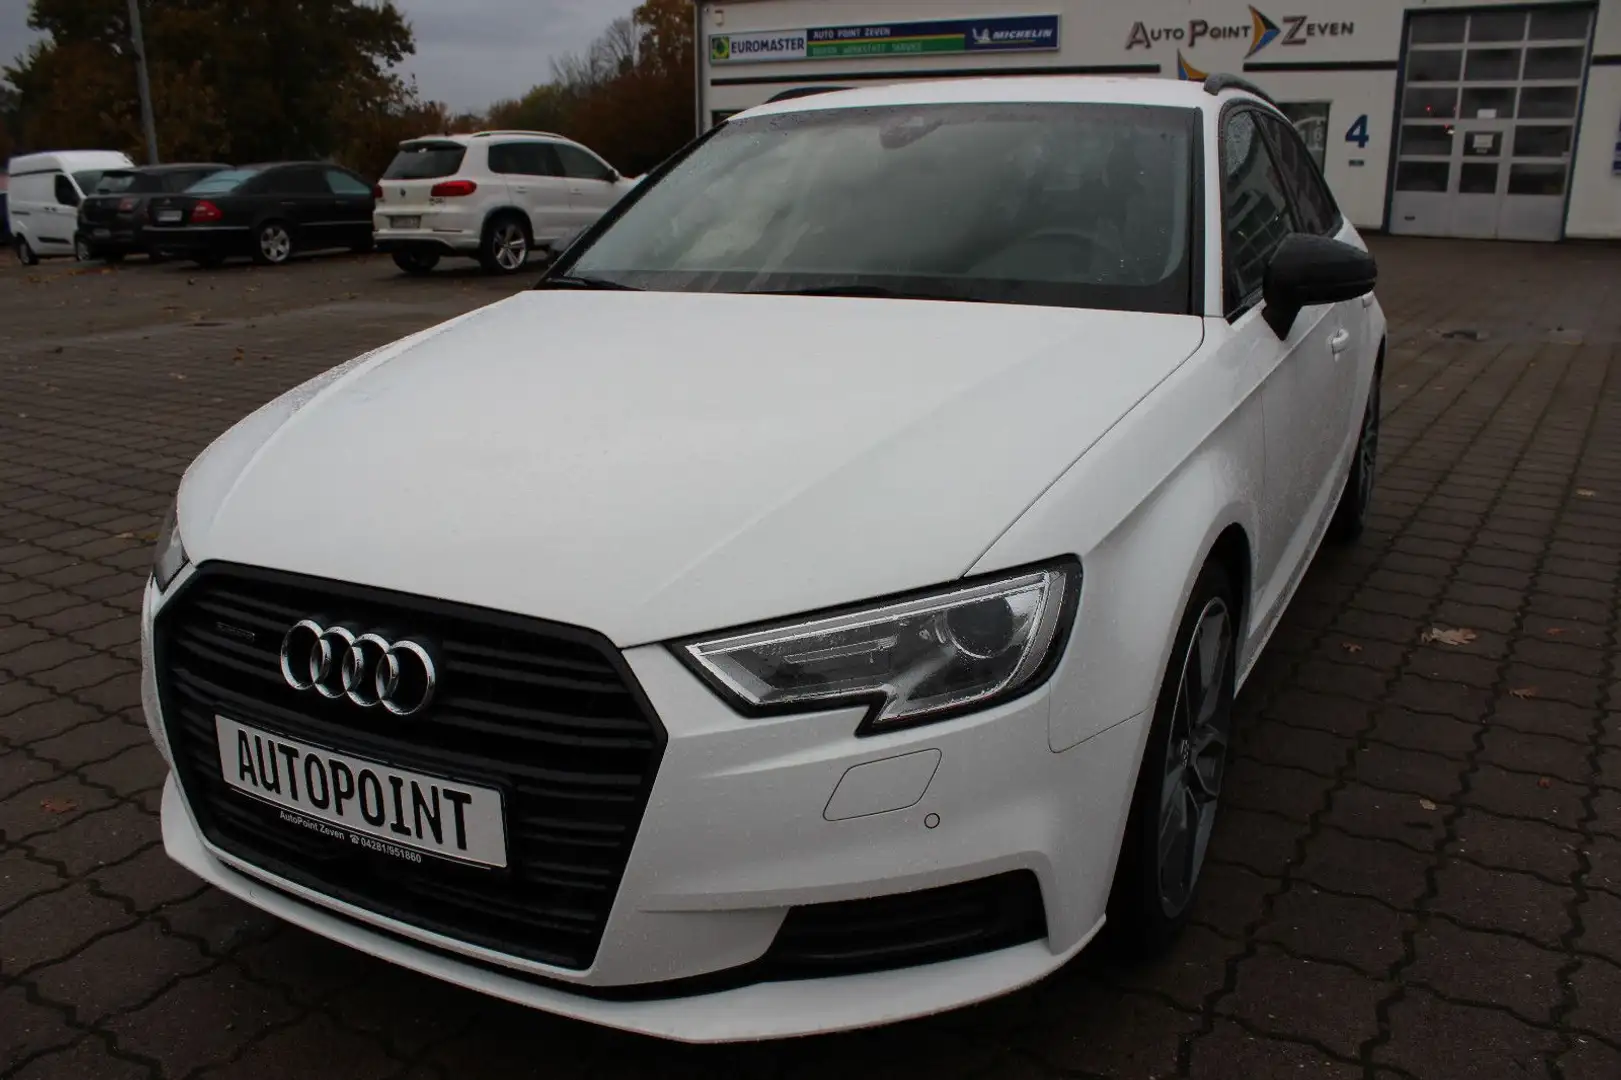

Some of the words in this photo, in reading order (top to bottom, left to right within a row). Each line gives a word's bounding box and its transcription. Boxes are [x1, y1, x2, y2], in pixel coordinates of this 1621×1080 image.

[730, 36, 805, 54] EUROMASTER
[812, 29, 834, 40] AUTO
[837, 28, 861, 39] POINT
[864, 27, 891, 37] ZEVEN
[992, 28, 1053, 40] MICHELIN
[1345, 114, 1369, 148] 4
[237, 729, 473, 850] AUTOPOINT
[279, 810, 319, 831] AutoPoint
[319, 823, 345, 841] Zeven
